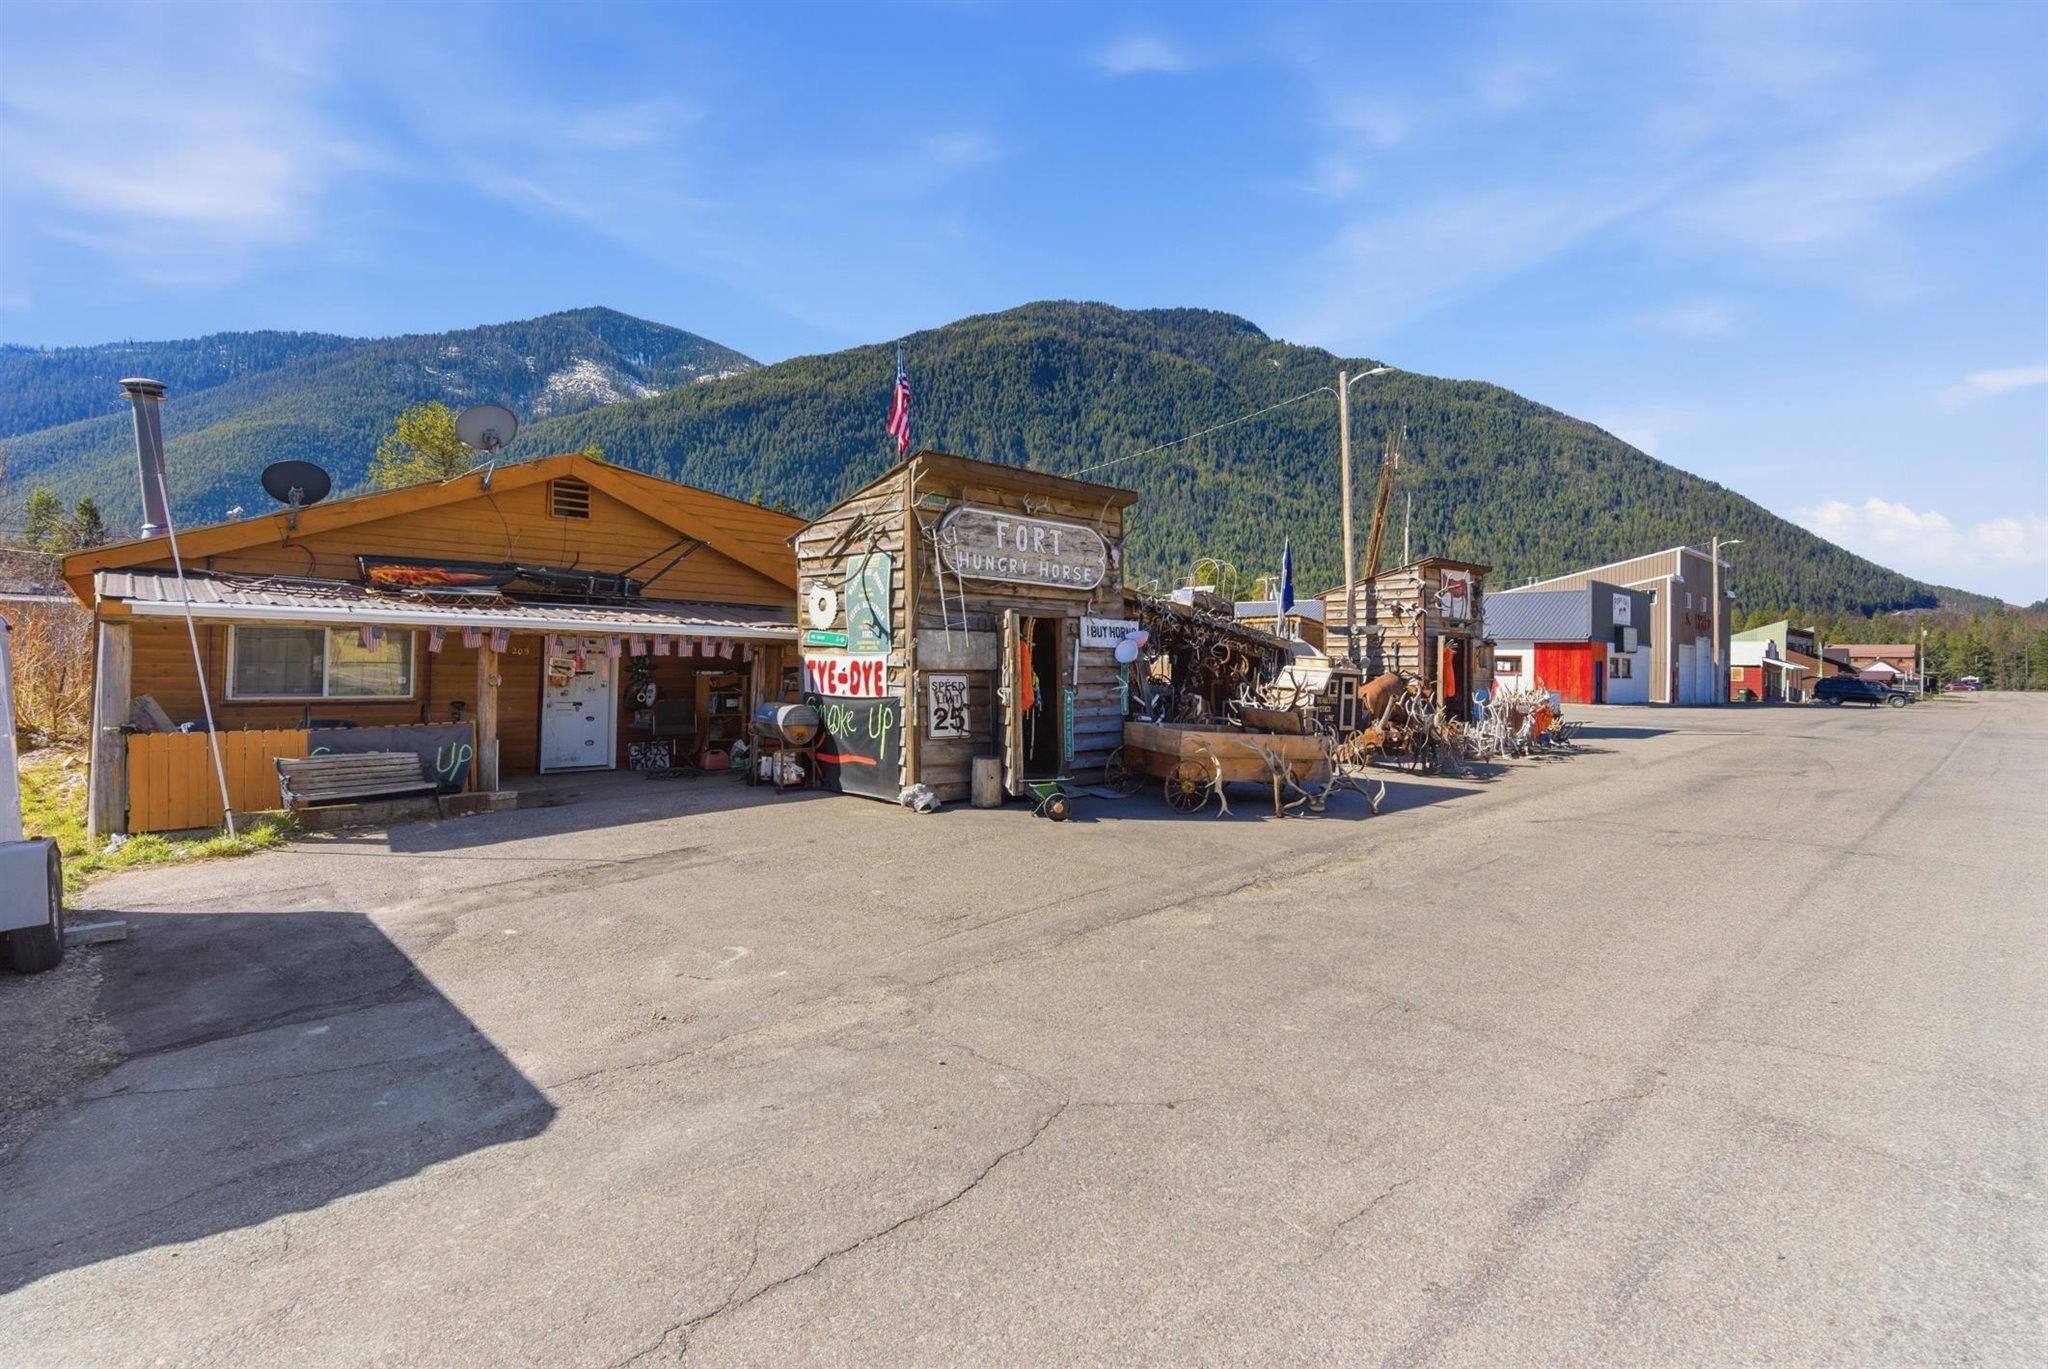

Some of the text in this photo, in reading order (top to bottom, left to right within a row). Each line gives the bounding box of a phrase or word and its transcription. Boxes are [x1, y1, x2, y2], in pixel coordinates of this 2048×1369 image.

[996, 520, 1063, 556] FORT
[958, 551, 1093, 582] HUNGRY HORSE
[1086, 625, 1090, 637] I
[1091, 626, 1108, 638] BUY
[806, 659, 884, 698] TYE-DYE
[931, 681, 966, 692] SPEED
[933, 707, 966, 732] 25
